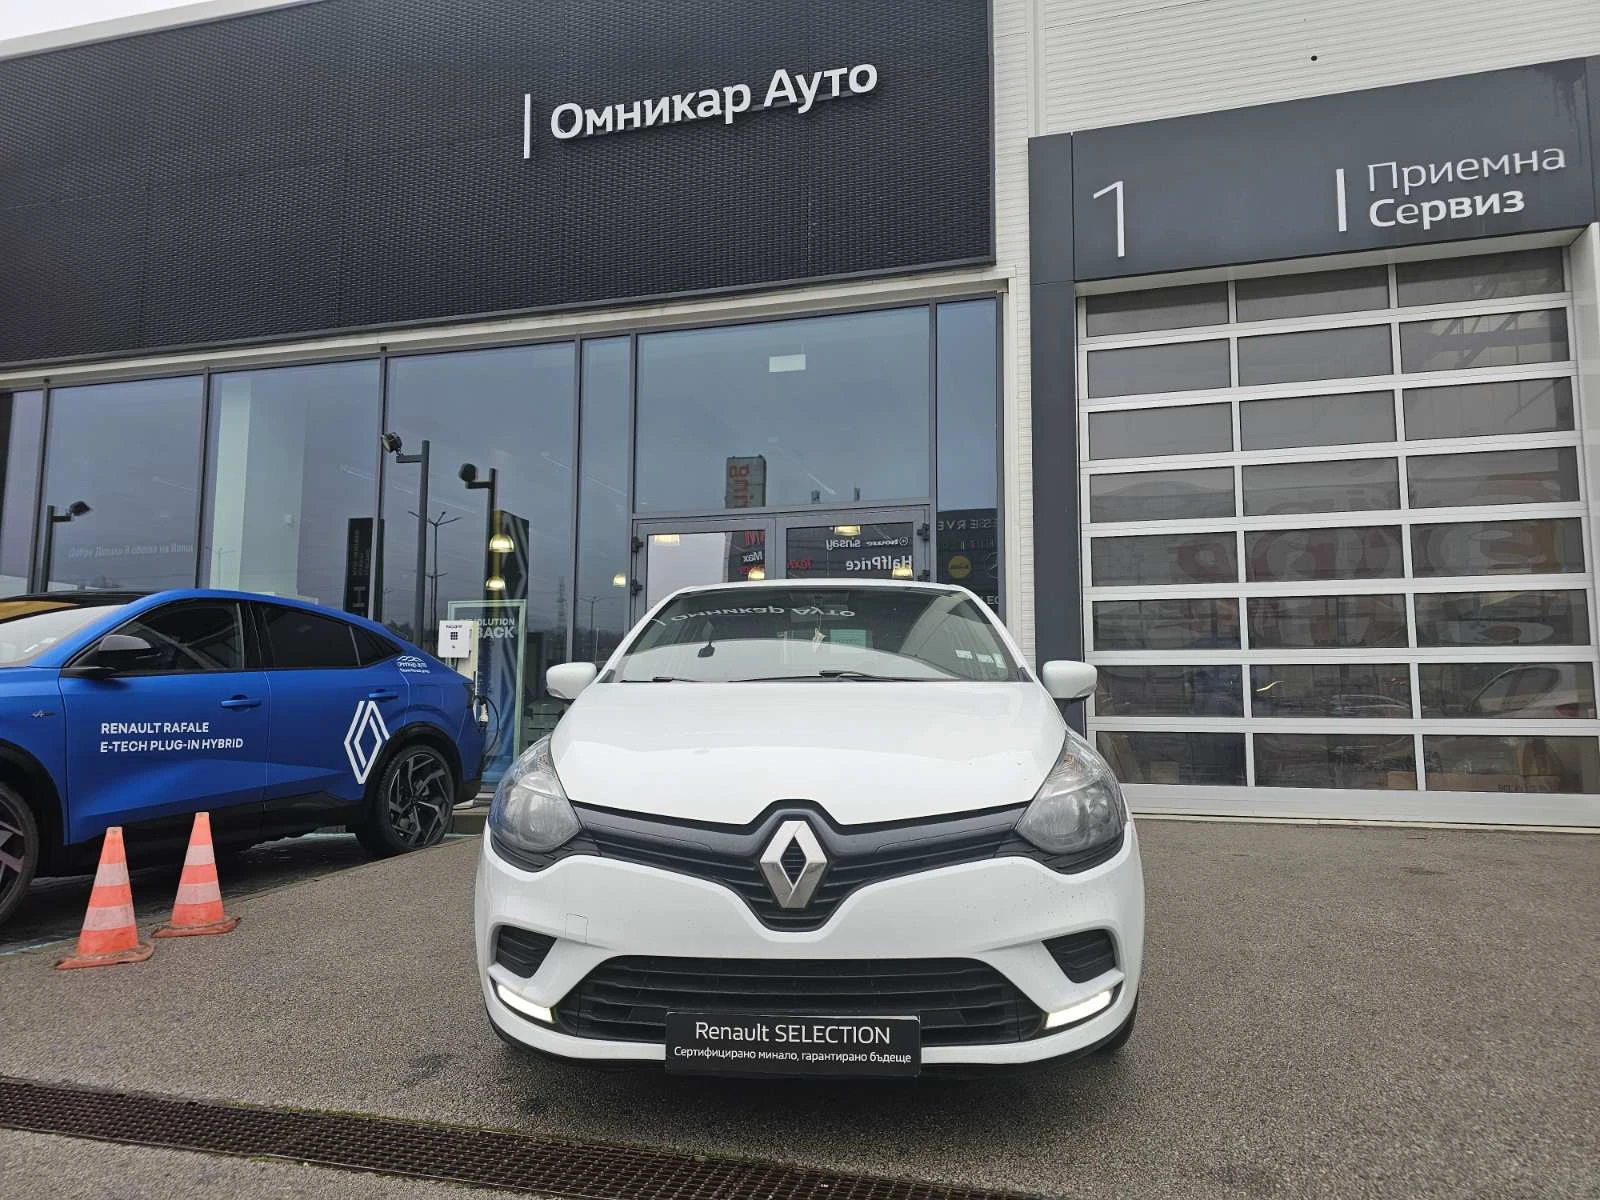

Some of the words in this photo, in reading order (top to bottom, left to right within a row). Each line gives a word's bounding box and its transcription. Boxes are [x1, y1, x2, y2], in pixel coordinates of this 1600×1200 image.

[550, 83, 751, 139] Омникар
[763, 63, 878, 114] Ауто
[1368, 147, 1566, 195] Приемна
[1093, 181, 1124, 257] 1
[1369, 190, 1525, 229] Сервиз
[101, 723, 161, 734] RENAULT
[164, 722, 209, 733] RAFALE
[100, 741, 149, 752] E-TECH
[150, 740, 200, 751] PLUG-IN
[202, 738, 244, 749] HYBRID
[695, 1022, 769, 1042] Renault
[775, 1024, 890, 1044] SELECTION
[674, 1046, 756, 1059] Сертифицирано
[758, 1050, 800, 1062] минало,
[801, 1052, 869, 1063] гарантирано
[870, 1052, 912, 1064] бъдеще
